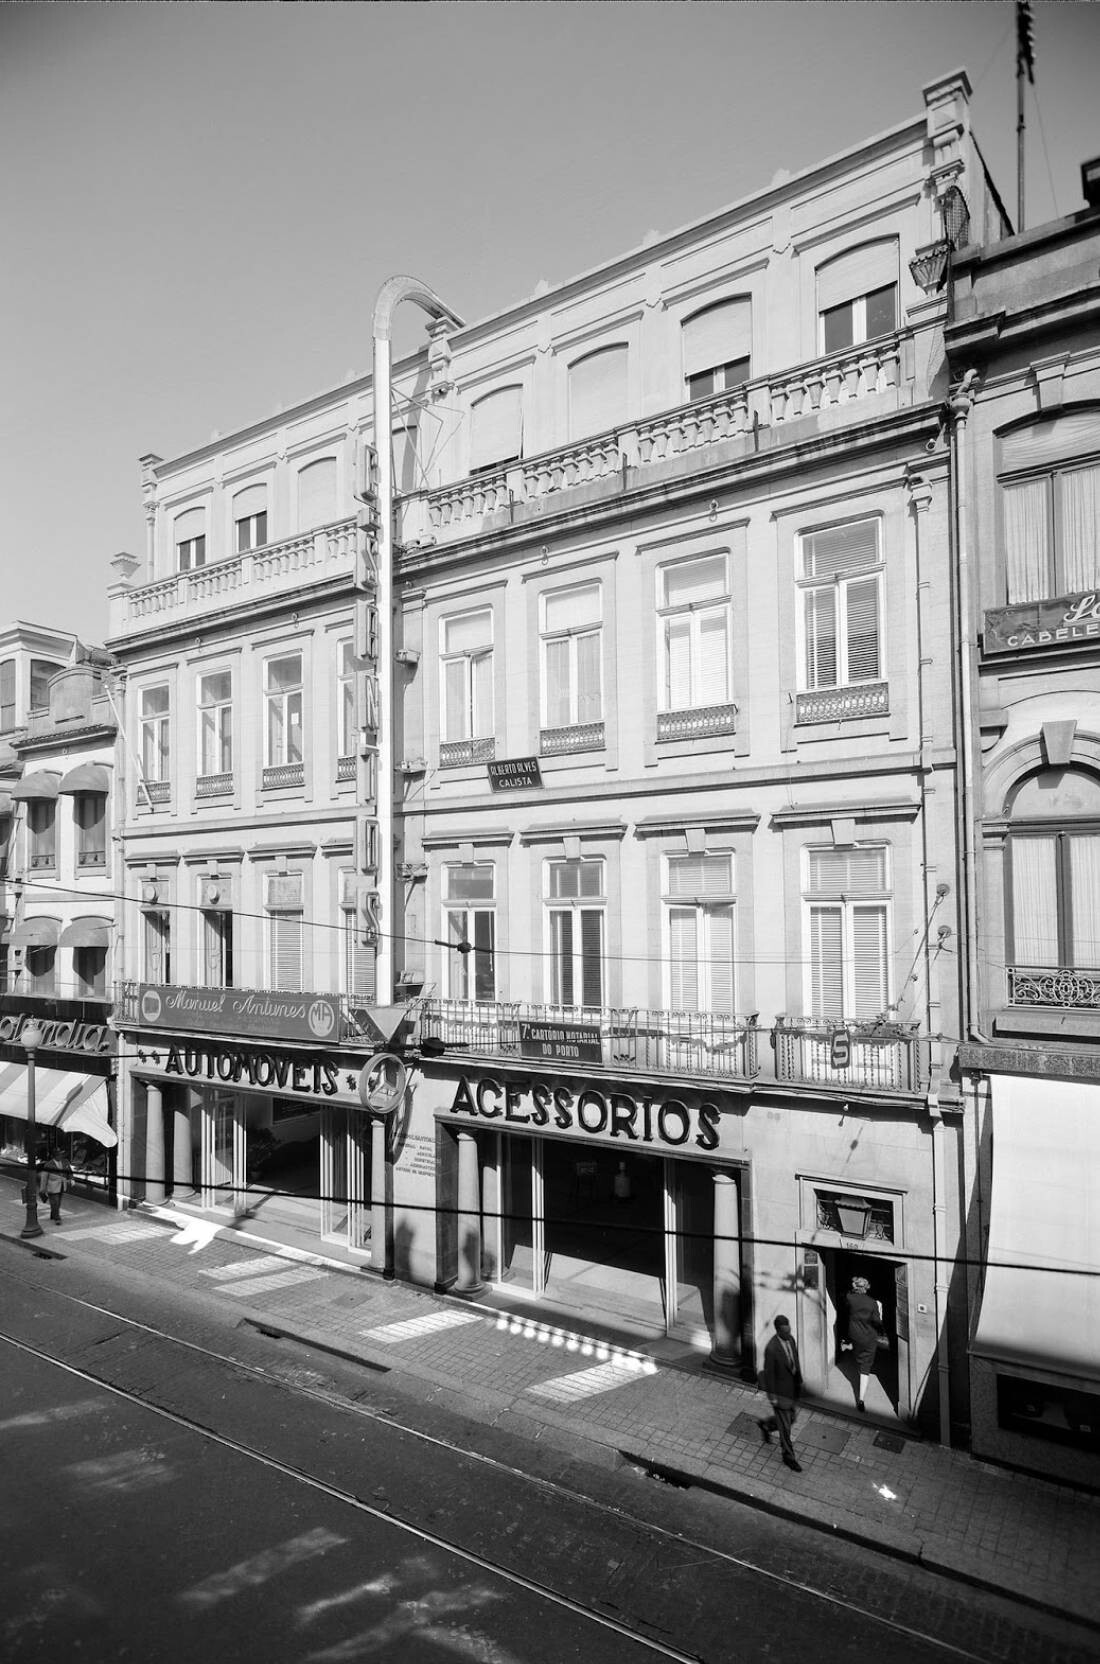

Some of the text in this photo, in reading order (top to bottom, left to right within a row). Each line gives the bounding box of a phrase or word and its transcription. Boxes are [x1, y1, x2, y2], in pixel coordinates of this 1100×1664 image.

[499, 777, 532, 788] CALISTA
[165, 990, 306, 1019] Manuel Antunes
[531, 1026, 565, 1041] CARTÓRIO
[566, 1031, 600, 1045] NOTARIAL
[542, 1043, 579, 1057] DO PORTO
[165, 1044, 340, 1095] AUTOMOVEIS
[449, 1073, 722, 1151] ACESSORIOS
